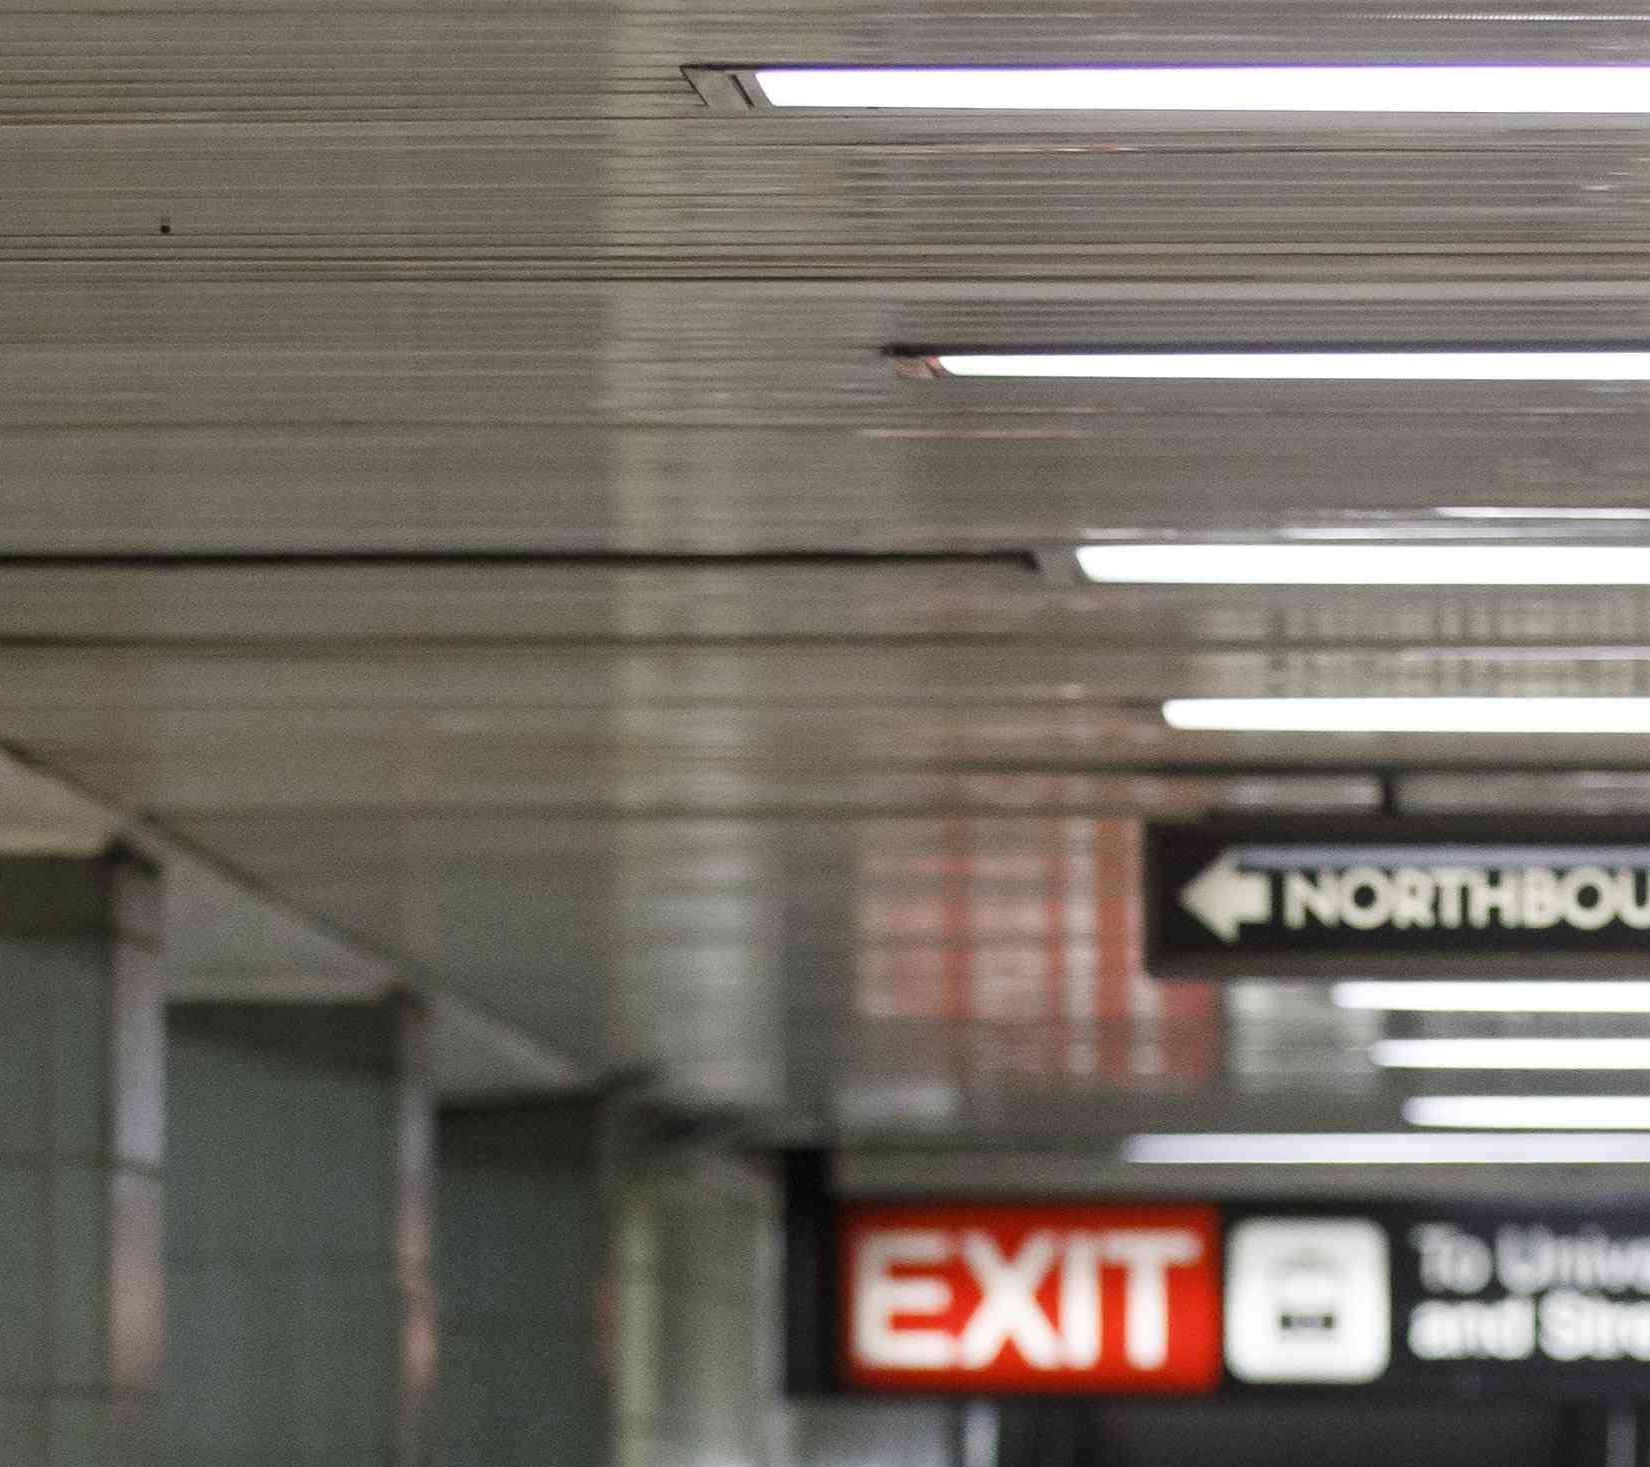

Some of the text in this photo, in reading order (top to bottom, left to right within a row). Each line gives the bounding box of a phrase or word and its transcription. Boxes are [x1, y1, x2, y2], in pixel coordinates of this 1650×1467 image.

[1408, 1223, 1493, 1296] To
[849, 1228, 1204, 1371] EXIT
[1408, 1296, 1536, 1360] and
